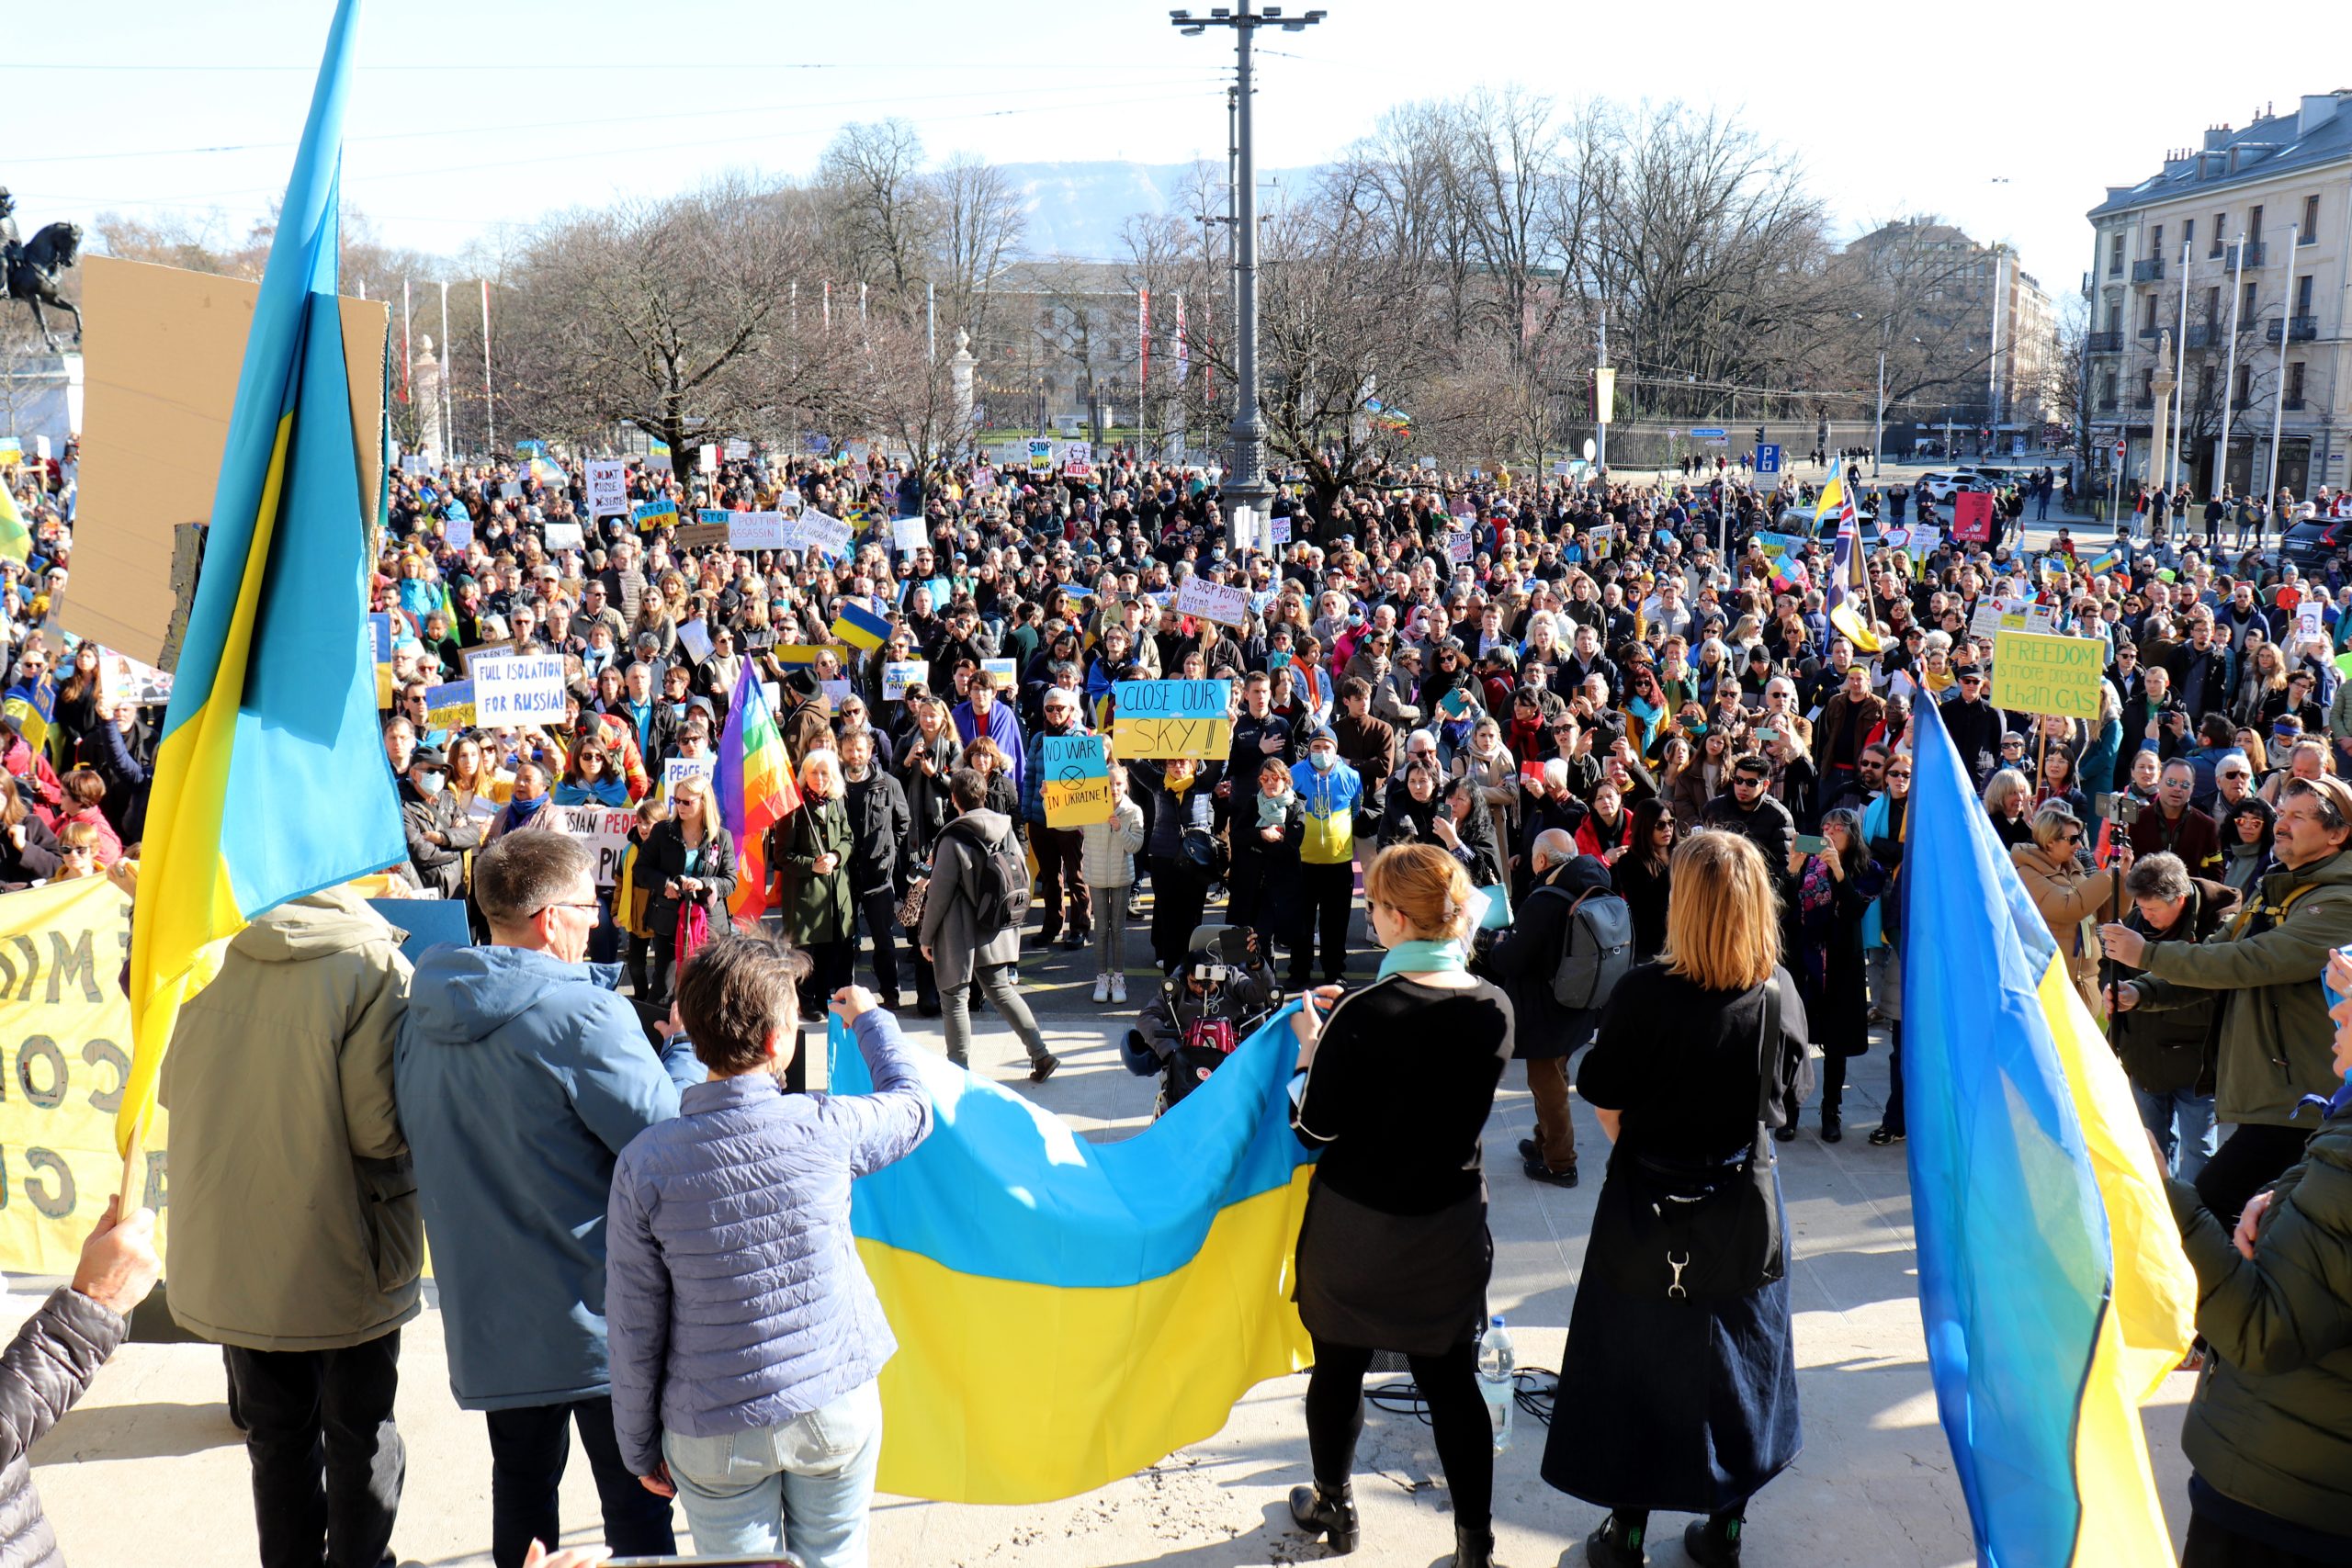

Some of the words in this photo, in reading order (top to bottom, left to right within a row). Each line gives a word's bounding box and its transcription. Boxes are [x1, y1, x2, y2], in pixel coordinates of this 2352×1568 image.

[1029, 441, 1052, 452] STOP
[1764, 446, 1772, 460] P
[593, 468, 620, 480] SOLDAT
[1030, 462, 1051, 471] WAR
[1067, 465, 1090, 475] KILLER
[639, 502, 672, 516] STOP
[646, 515, 670, 527] WAR
[738, 515, 780, 526] POUTINE
[806, 512, 832, 529] STOP
[730, 528, 775, 538] ASSASSIN
[808, 527, 841, 547] UKRAINE
[1272, 526, 1290, 536] STOP
[1451, 533, 1471, 542] STOP
[1592, 530, 1610, 538] STOP
[1195, 581, 1217, 595] STOP
[1219, 587, 1248, 604] PUTIN
[2006, 638, 2096, 668] FREEDOM
[480, 664, 501, 681] FULL
[506, 659, 560, 680] ISOLATION
[890, 671, 918, 682] STOP
[1998, 660, 2007, 677] is
[2009, 664, 2043, 681] more
[2049, 668, 2100, 687] precious
[484, 694, 507, 713] FOR
[514, 688, 564, 712] RUSSIA!
[1123, 683, 1170, 711] CLOSE
[1182, 682, 1216, 710] OUR
[2006, 683, 2051, 706] than
[2055, 688, 2097, 712] GAS
[432, 710, 453, 725] OUR
[458, 704, 476, 717] SKY
[1133, 718, 1196, 752] SKY
[1045, 741, 1061, 762] NO
[1065, 739, 1097, 760] WAR
[1046, 795, 1059, 810] IN
[1065, 790, 1101, 806] UKRAINE
[567, 812, 597, 832] SSIAN
